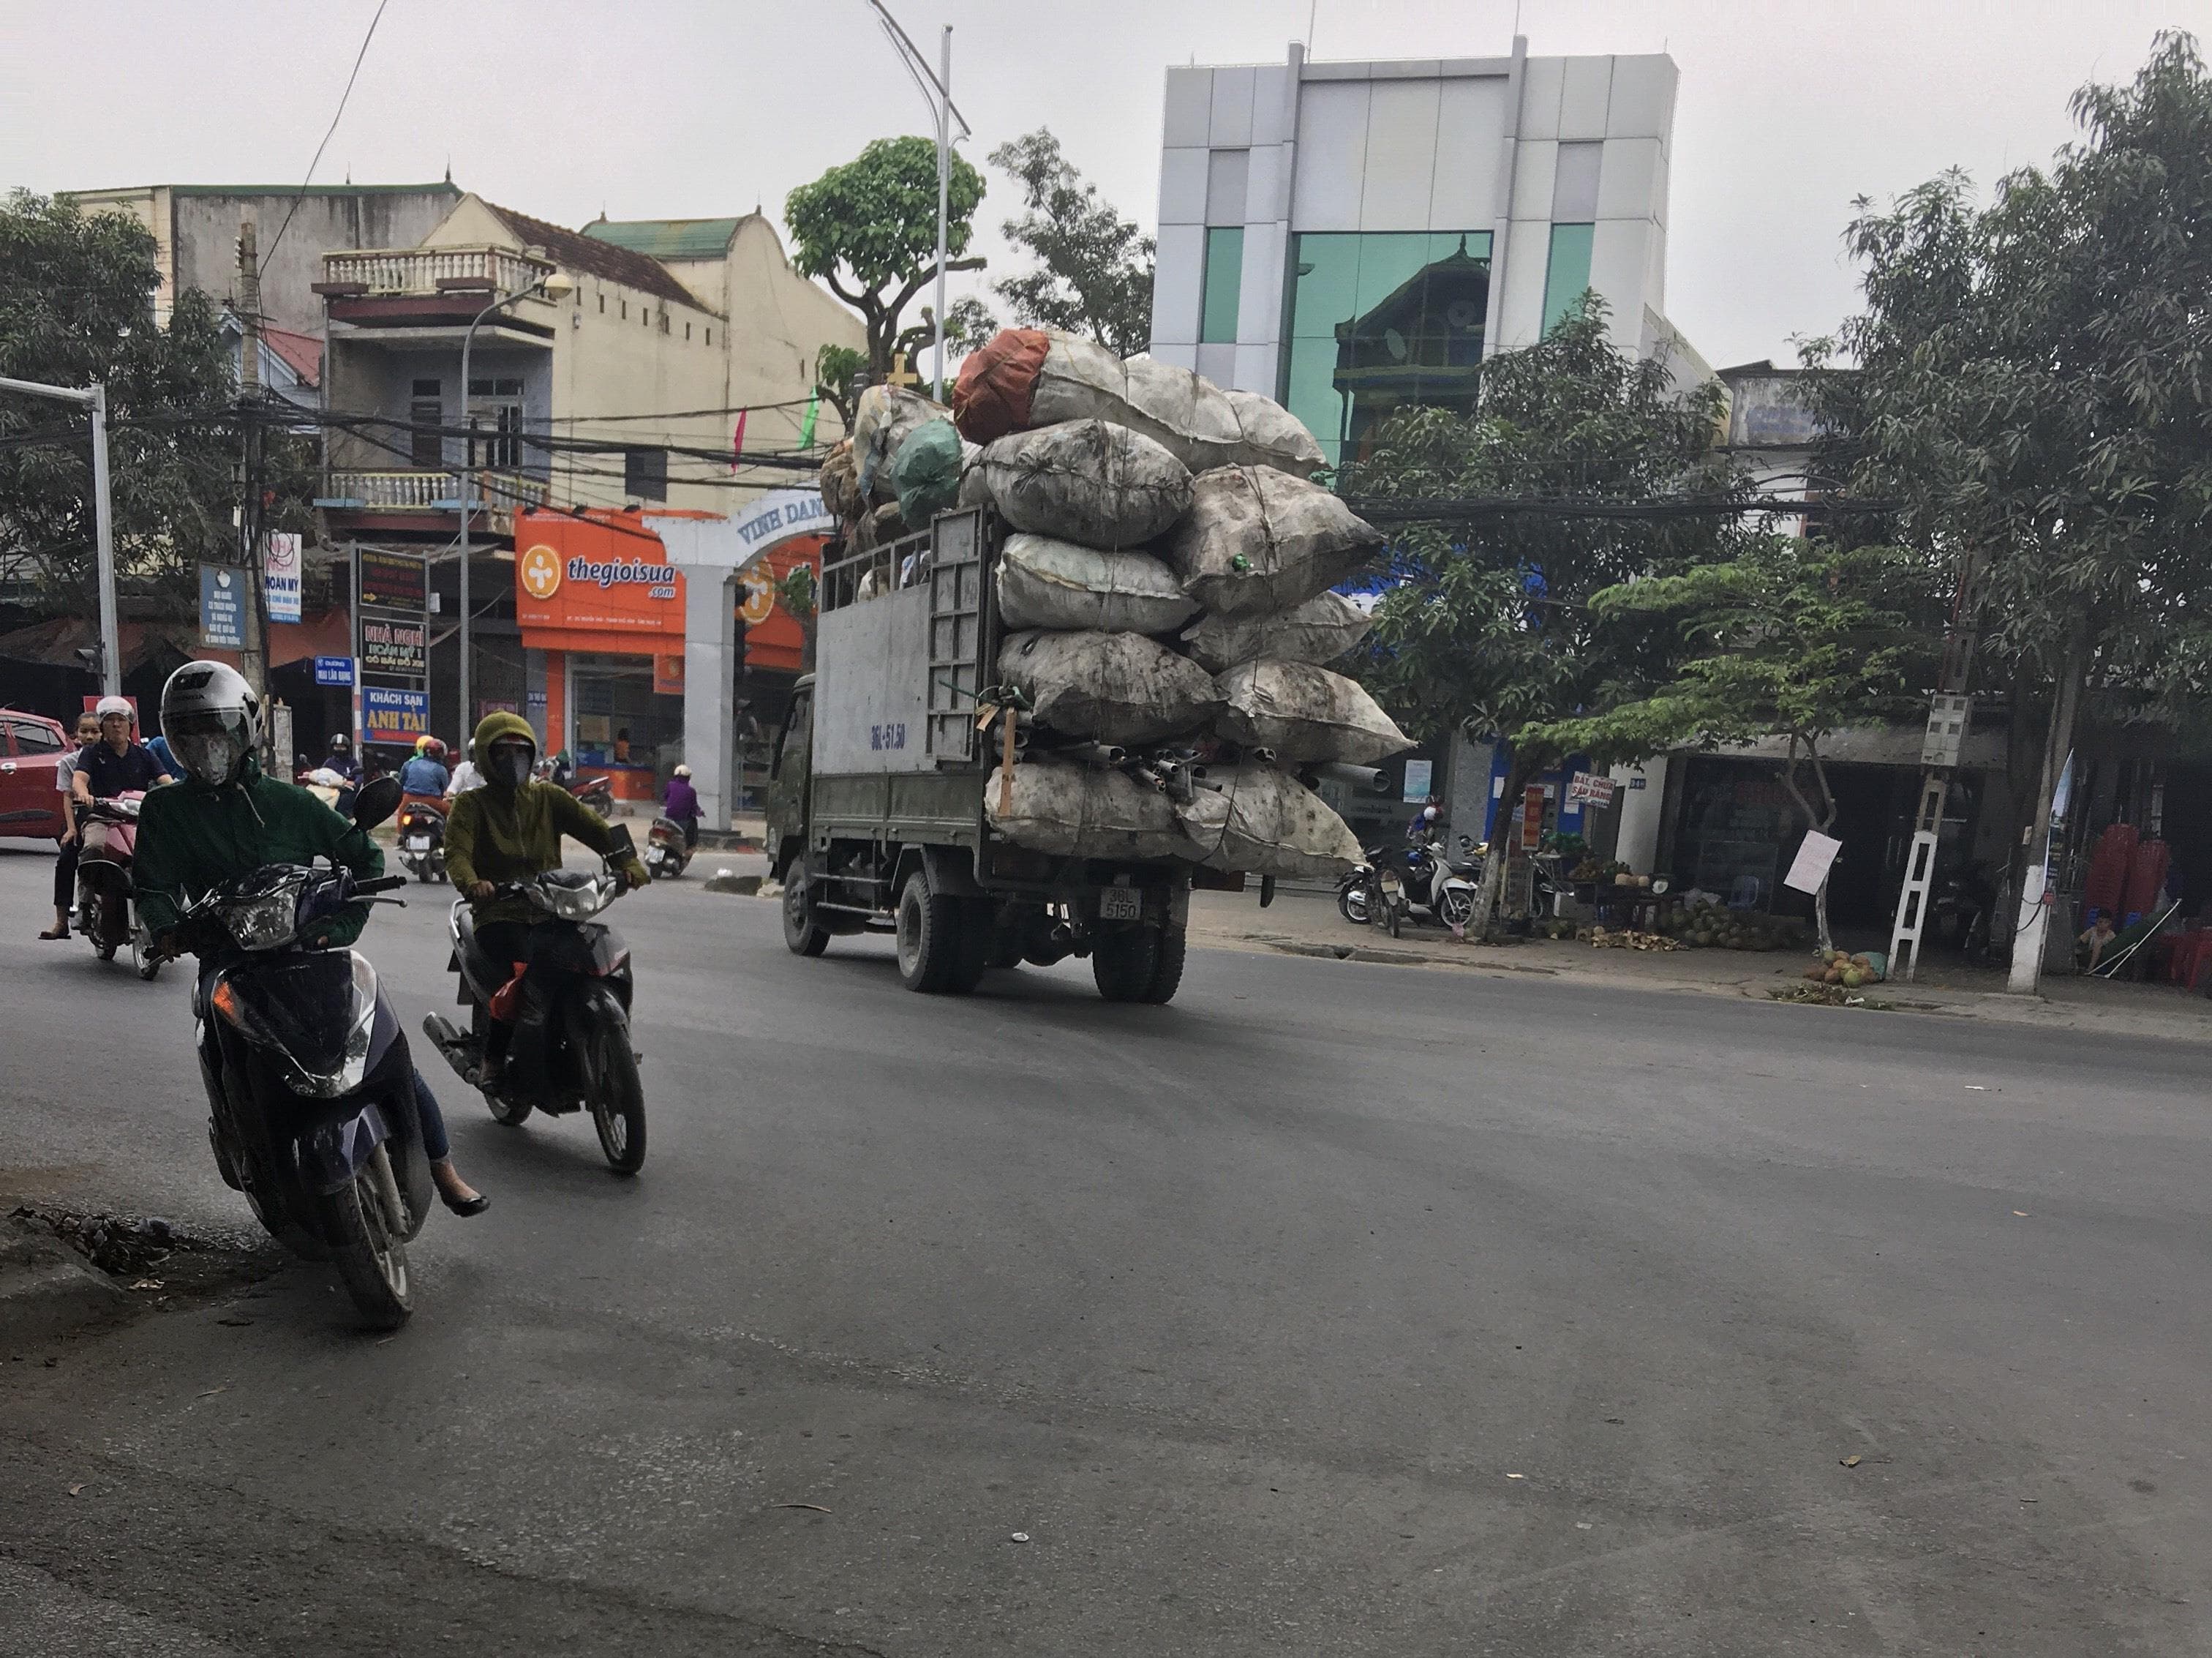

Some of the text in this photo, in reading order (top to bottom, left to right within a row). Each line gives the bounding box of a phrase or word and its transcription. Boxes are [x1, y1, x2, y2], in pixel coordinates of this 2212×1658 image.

[785, 498, 830, 525] DAN
[567, 554, 676, 590] thegioisua
[647, 585, 677, 599] .com
[365, 623, 424, 647] NHÀ NGHỈ
[370, 690, 424, 708] KHÁCH SẠN
[367, 706, 426, 732] ANH TÀI
[1106, 902, 1137, 918] 5150
